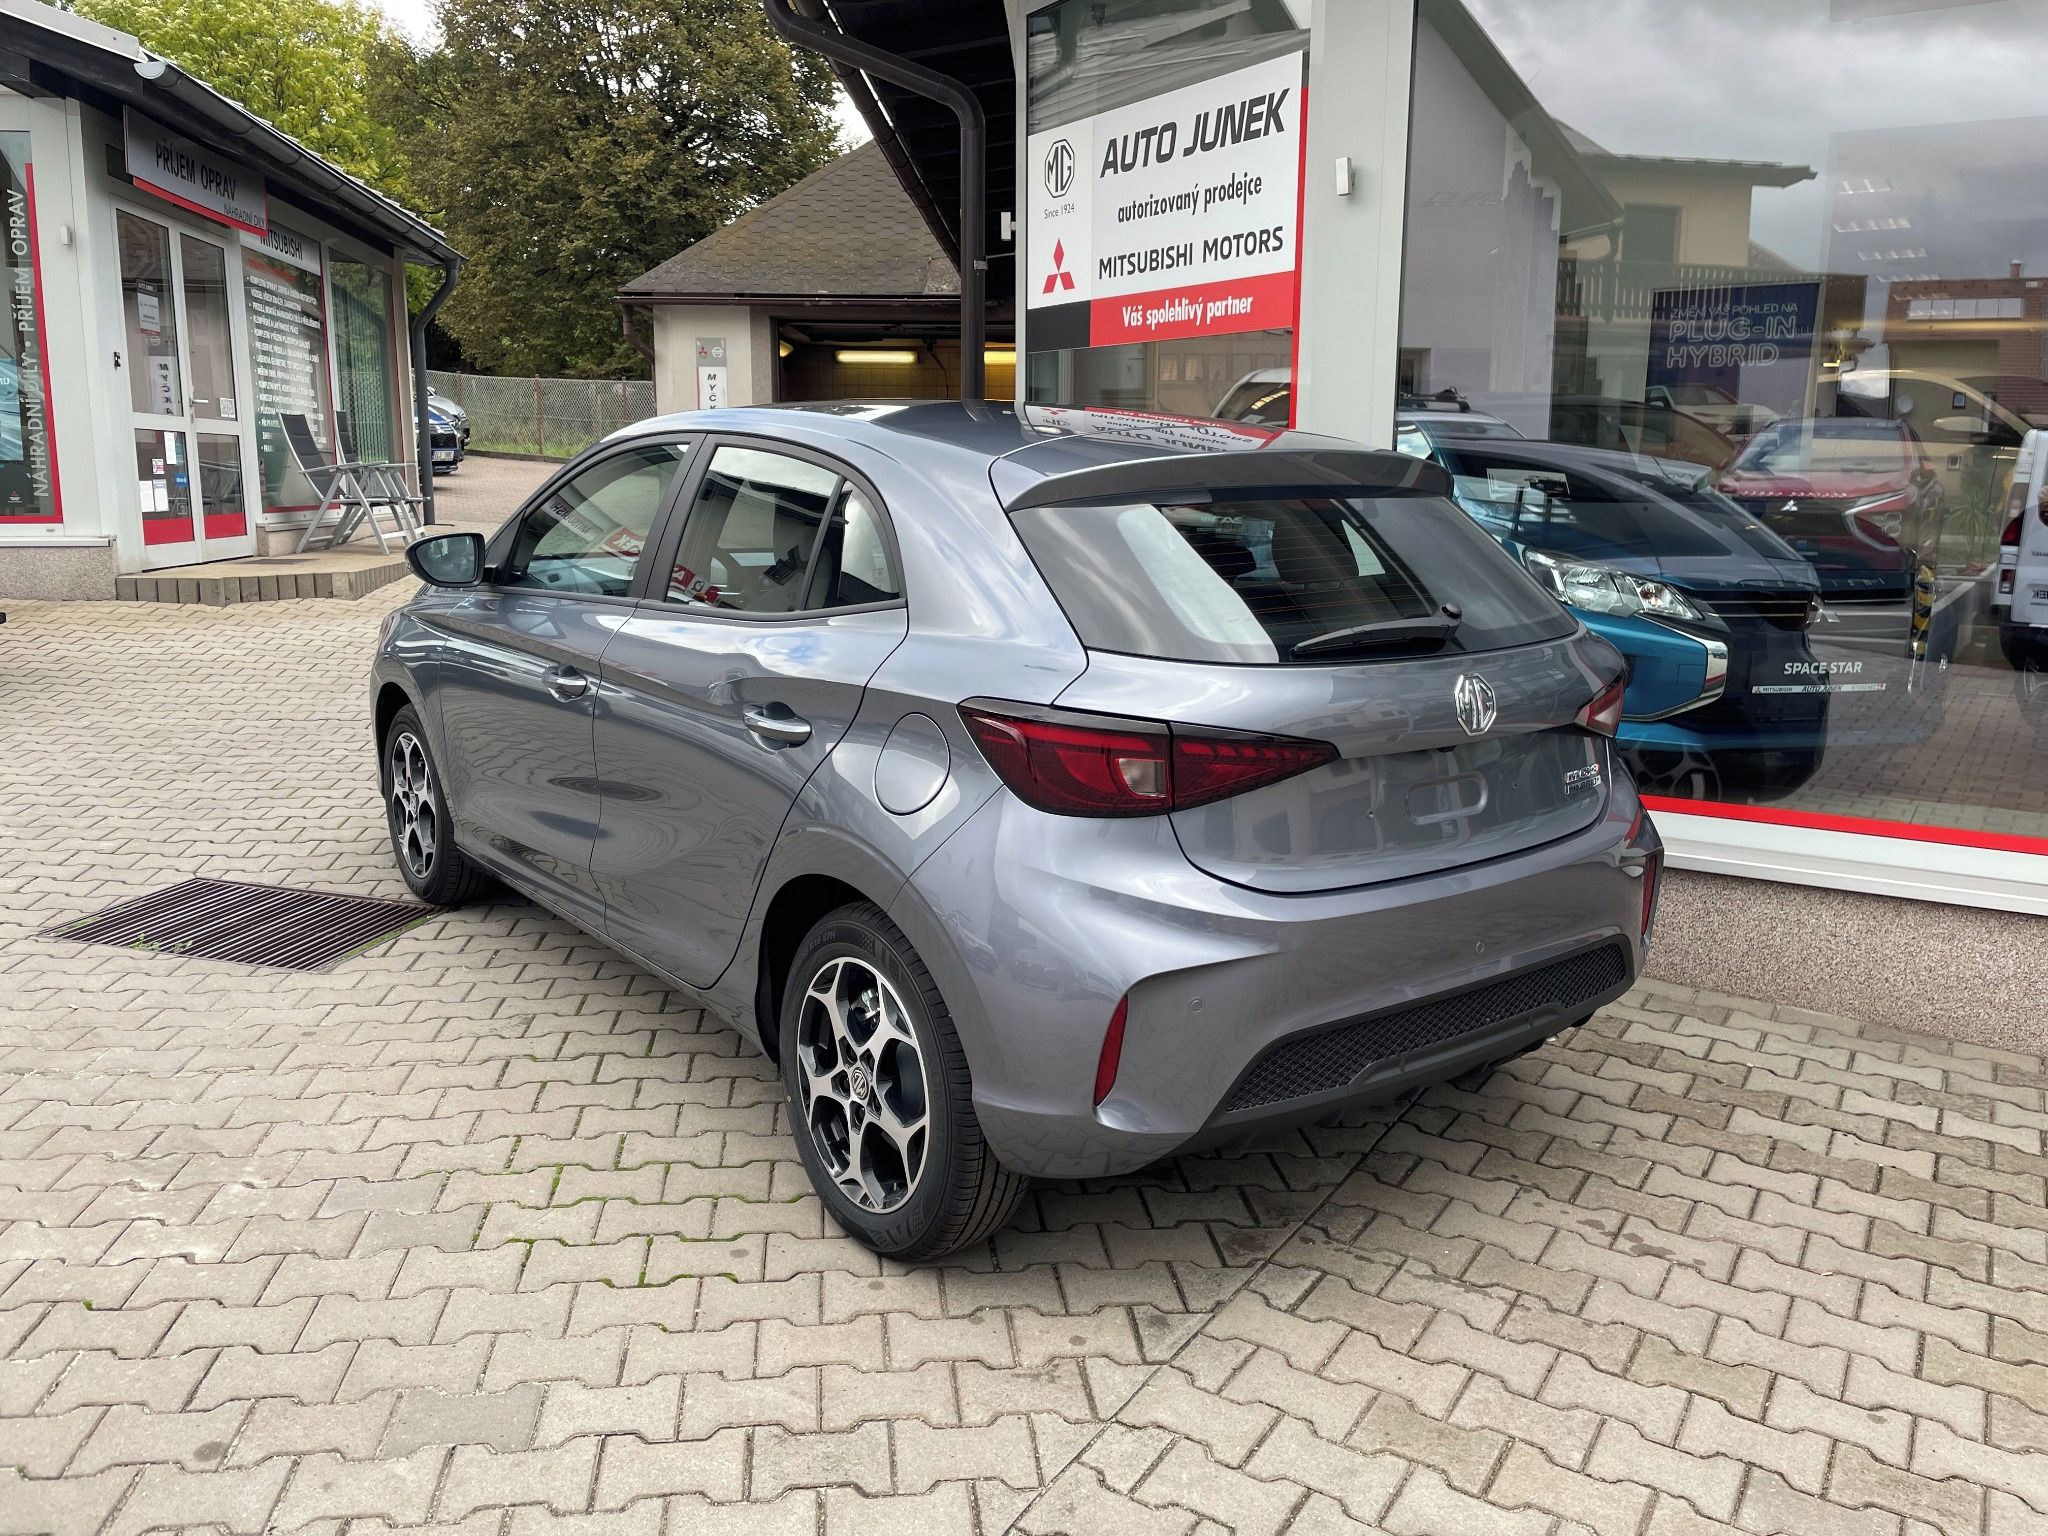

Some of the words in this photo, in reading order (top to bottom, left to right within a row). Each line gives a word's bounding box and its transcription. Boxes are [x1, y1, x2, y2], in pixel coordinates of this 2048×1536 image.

[1100, 121, 1177, 178] AUTO
[1183, 87, 1291, 157] JUNEK
[156, 138, 196, 185] PŘÍJEM
[200, 165, 237, 201] OPRAV
[1046, 142, 1073, 195] MG
[6, 189, 28, 256] OPRAV
[1044, 208, 1059, 219] Since
[1061, 201, 1075, 215] 1924
[1118, 183, 1200, 223] autorizovaný
[1203, 172, 1262, 213] prodejce
[1098, 242, 1193, 280] MITSUBISHI
[1202, 226, 1284, 263] MOTORS
[11, 267, 35, 332] PŘÍJEM
[1122, 305, 1143, 327] Váš
[1146, 297, 1203, 330] spolehlivý
[1206, 296, 1253, 324] partner
[1731, 303, 1779, 314] POHLED
[1781, 302, 1798, 313] NA
[1666, 342, 1779, 368] HYBRID
[1669, 316, 1796, 343] PLUG-IN
[20, 397, 49, 497] NÁHRADNÍ
[1783, 662, 1827, 675] SPACE
[1829, 661, 1863, 675] STAR
[1456, 676, 1494, 733] MG
